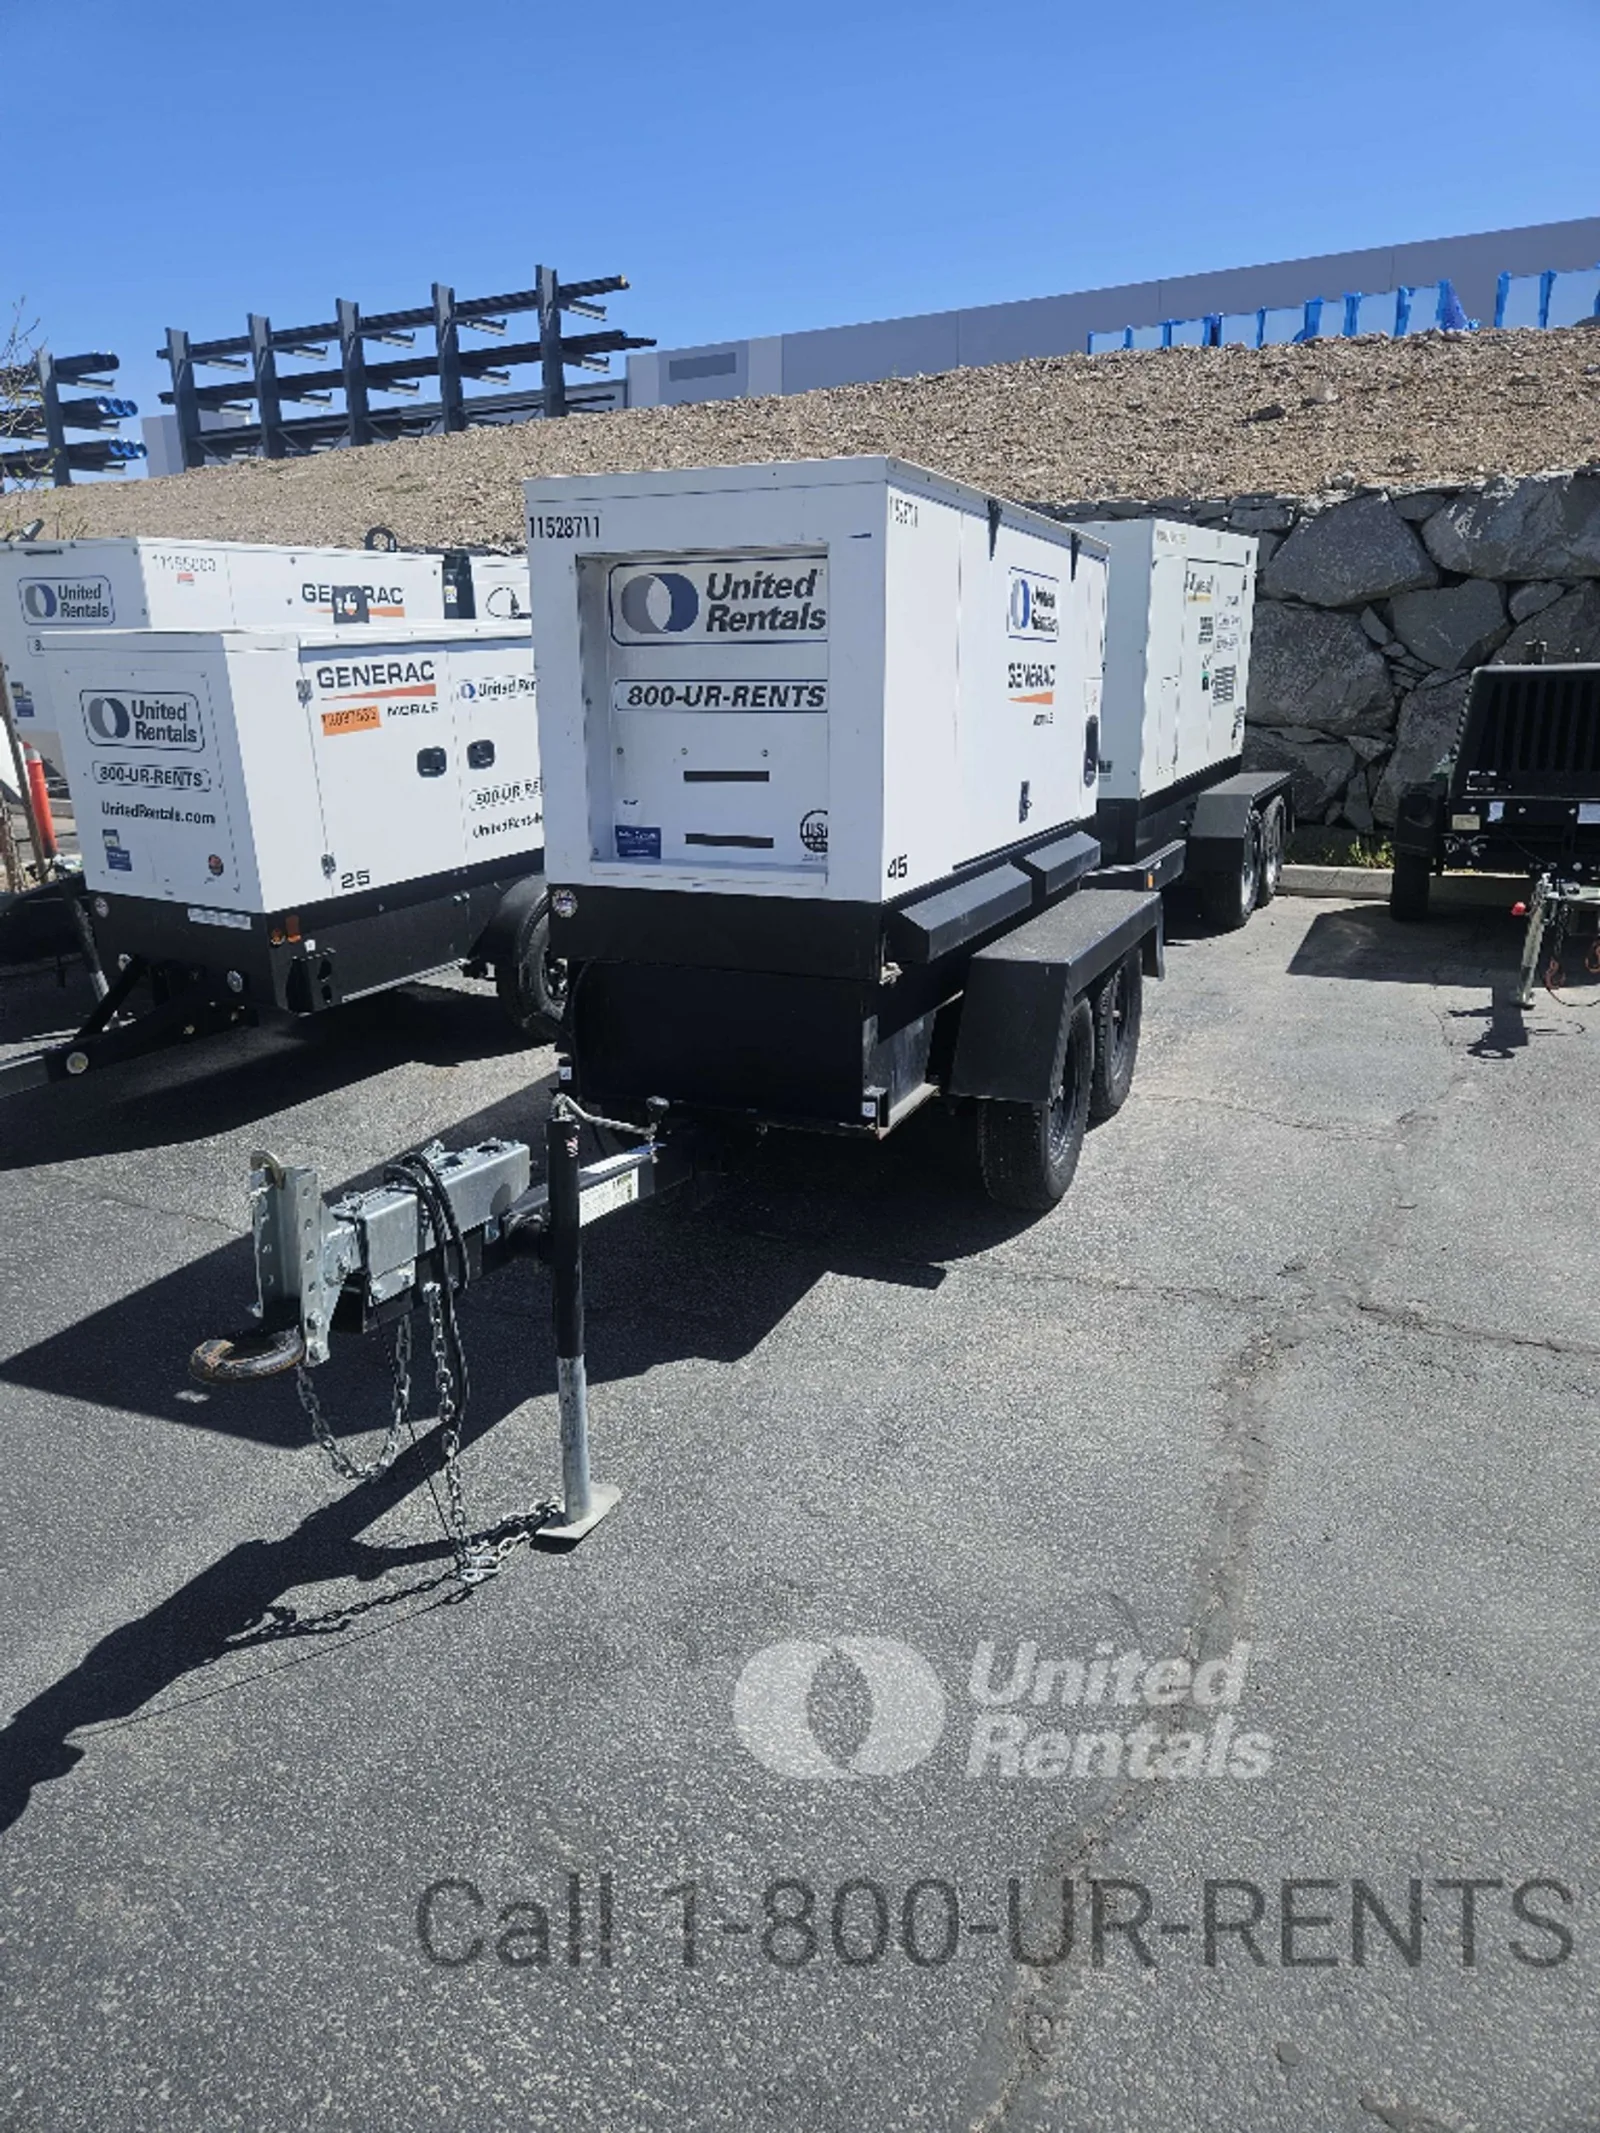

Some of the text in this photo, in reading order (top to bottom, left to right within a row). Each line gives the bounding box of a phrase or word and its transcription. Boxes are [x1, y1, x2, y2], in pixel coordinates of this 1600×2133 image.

[529, 516, 600, 539] 11528711
[58, 584, 101, 600] United
[302, 583, 404, 604] GERAC
[706, 569, 818, 600] United
[60, 602, 109, 618] Rentals
[706, 603, 827, 632] Rentals
[317, 660, 435, 688] GENERAC
[627, 685, 826, 707] 800-UR-RENTS
[131, 700, 187, 721] United
[135, 721, 197, 743] Rentals
[100, 766, 203, 786] 800-UR-RENTS
[888, 854, 907, 879] 45
[341, 869, 370, 888] 25
